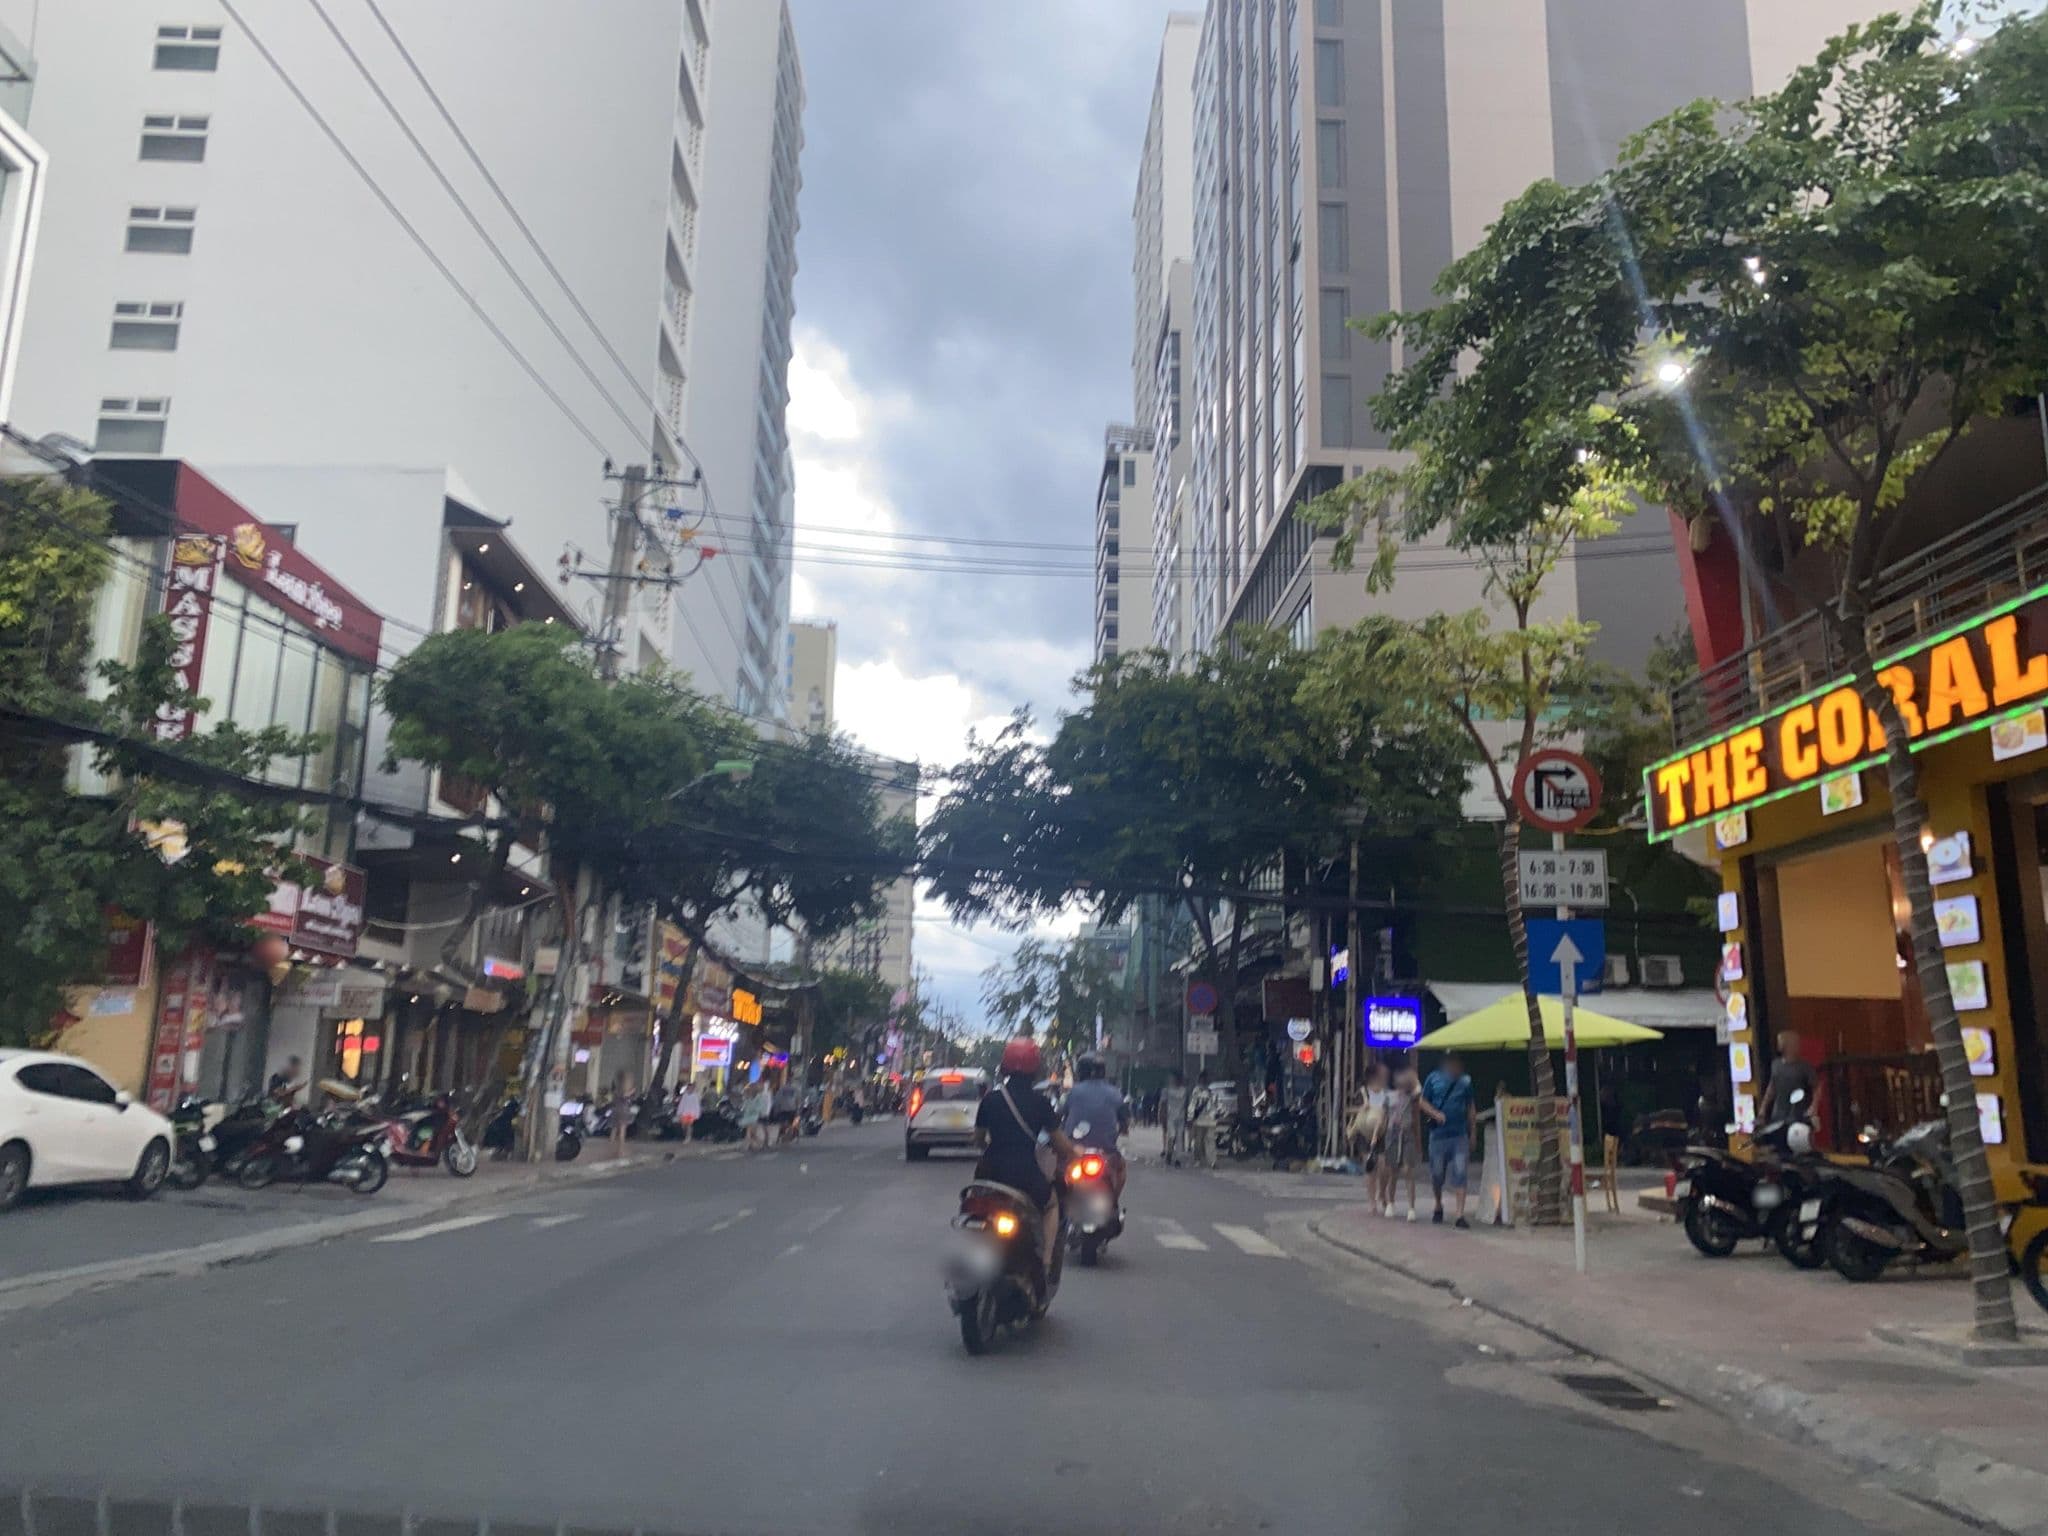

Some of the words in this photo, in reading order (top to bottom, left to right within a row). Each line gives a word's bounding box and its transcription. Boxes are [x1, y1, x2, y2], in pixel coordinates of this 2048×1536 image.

[1657, 725, 1768, 827] THE
[1529, 859, 1556, 876] 6:30
[1568, 859, 1595, 876] 7:30
